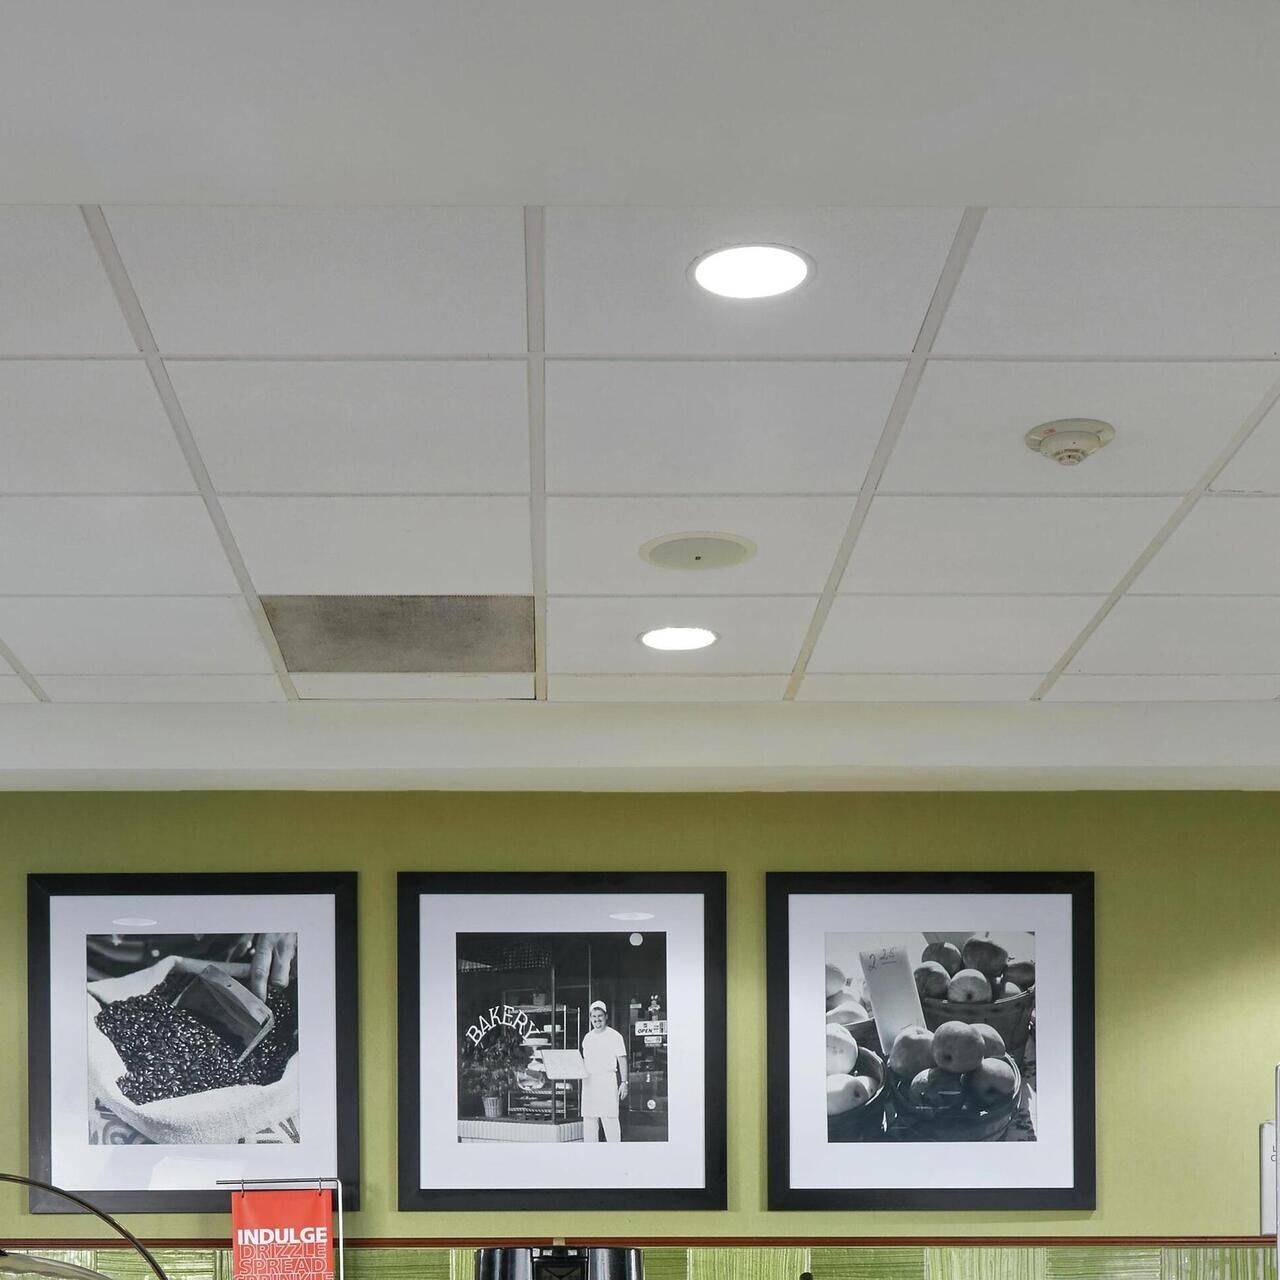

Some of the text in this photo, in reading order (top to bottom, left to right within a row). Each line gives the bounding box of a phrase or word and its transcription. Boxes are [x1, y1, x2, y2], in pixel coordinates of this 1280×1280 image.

[466, 1005, 540, 1046] BAKERY
[237, 1227, 328, 1245] INDULGE
[240, 1243, 327, 1259] DRIZZLE
[239, 1257, 327, 1275] SPREAD
